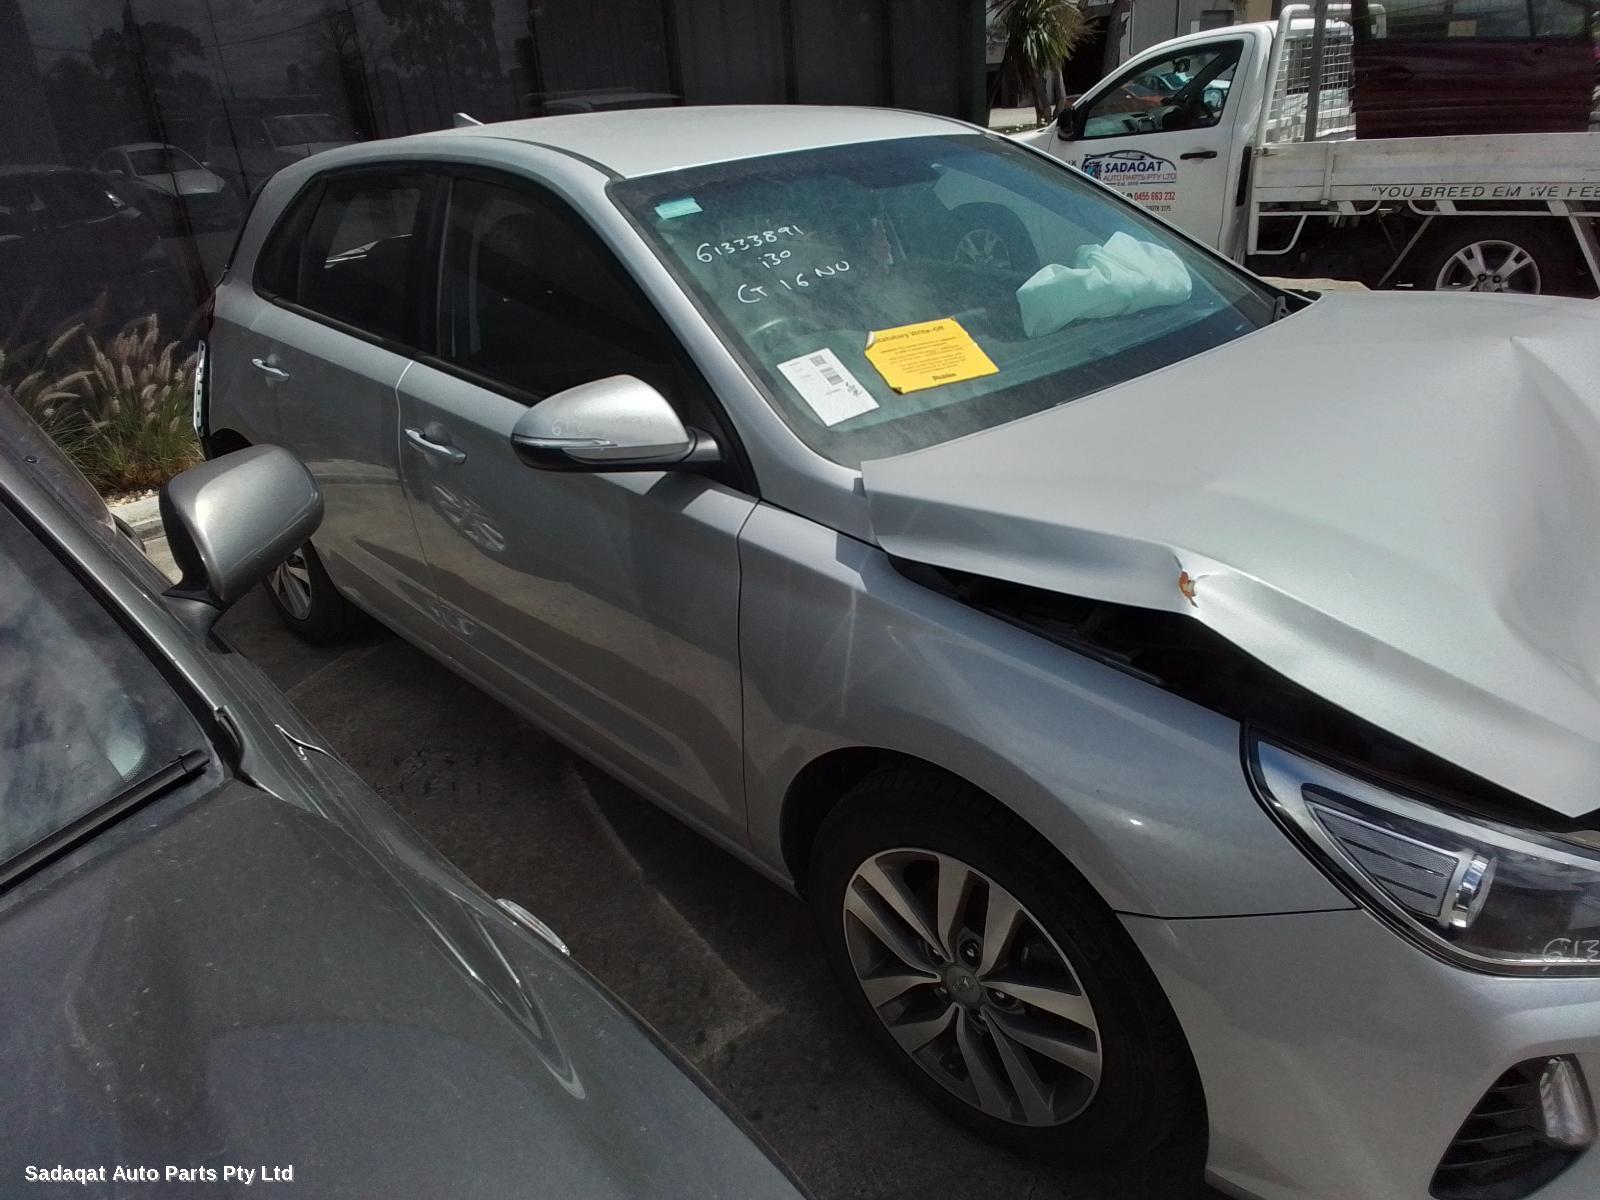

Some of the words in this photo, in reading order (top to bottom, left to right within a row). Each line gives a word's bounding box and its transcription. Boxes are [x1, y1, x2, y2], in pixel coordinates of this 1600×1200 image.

[1104, 161, 1163, 173] SADAQAT
[1134, 192, 1149, 200] 0455
[1163, 192, 1175, 200] 232
[1420, 186, 1486, 198] BREED
[1492, 186, 1522, 198] EM
[1529, 185, 1560, 198] WE
[758, 250, 791, 268] i30
